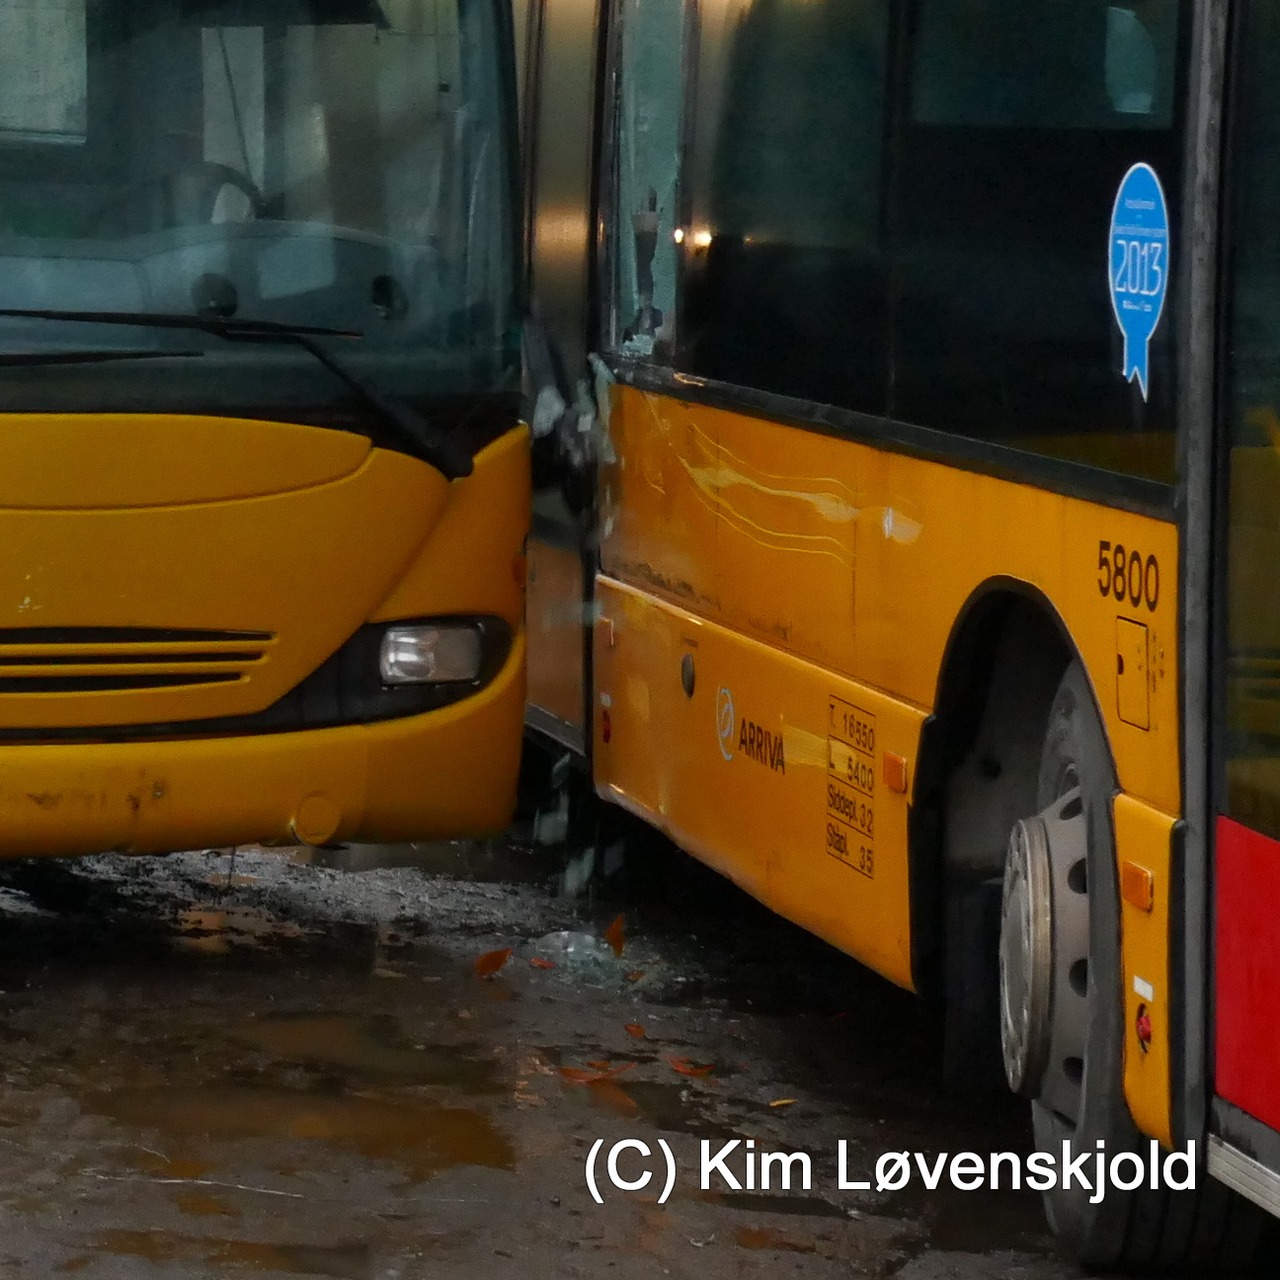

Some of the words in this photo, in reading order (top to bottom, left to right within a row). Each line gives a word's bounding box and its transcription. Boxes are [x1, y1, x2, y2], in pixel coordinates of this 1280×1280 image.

[1115, 239, 1162, 297] 2013
[1097, 540, 1159, 612] 5800
[738, 718, 786, 775] ARRIVA
[843, 712, 874, 752] 16550
[847, 756, 874, 792] 5400
[860, 803, 874, 833] 32
[859, 845, 874, 873] 35
